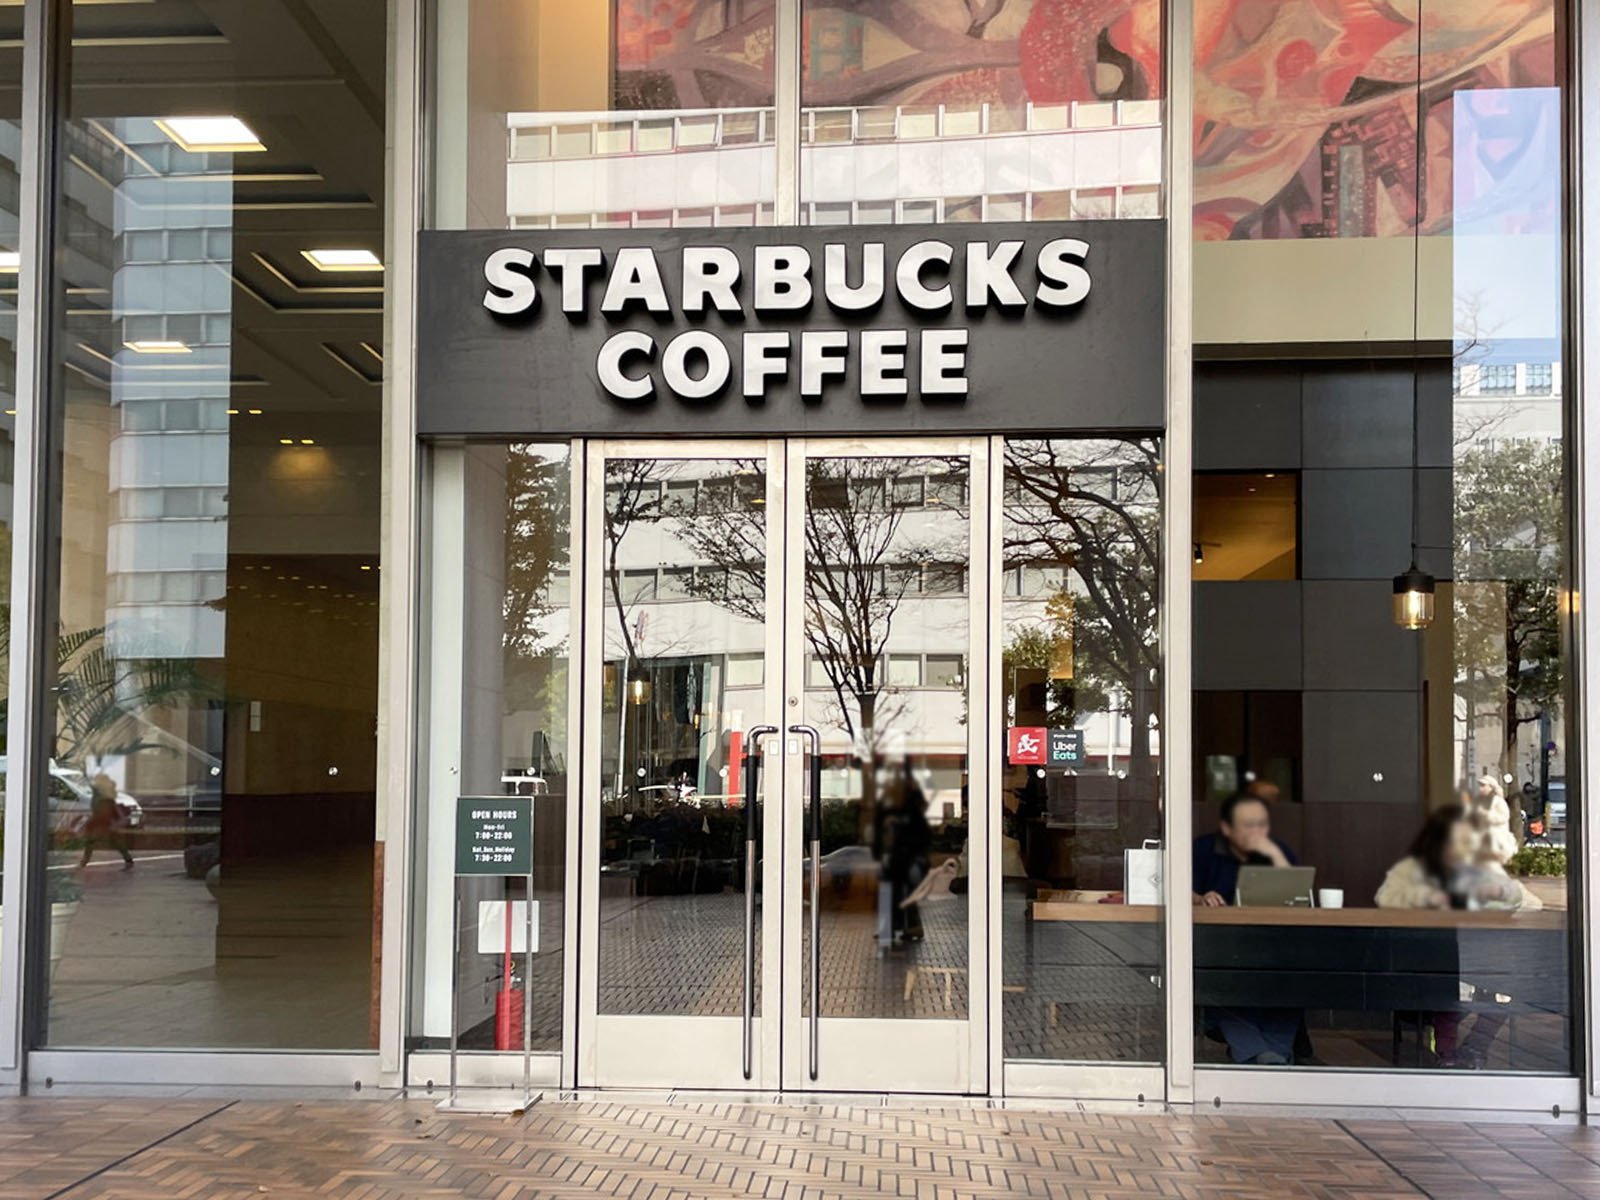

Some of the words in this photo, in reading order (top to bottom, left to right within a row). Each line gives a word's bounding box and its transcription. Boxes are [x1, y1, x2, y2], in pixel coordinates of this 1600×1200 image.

[483, 237, 1093, 317] STARBUCKS
[597, 328, 970, 400] COFFEE
[1053, 741, 1077, 750] Uber
[1053, 751, 1077, 760] Eats
[472, 810, 491, 819] OPEN
[493, 810, 517, 819] HOURS
